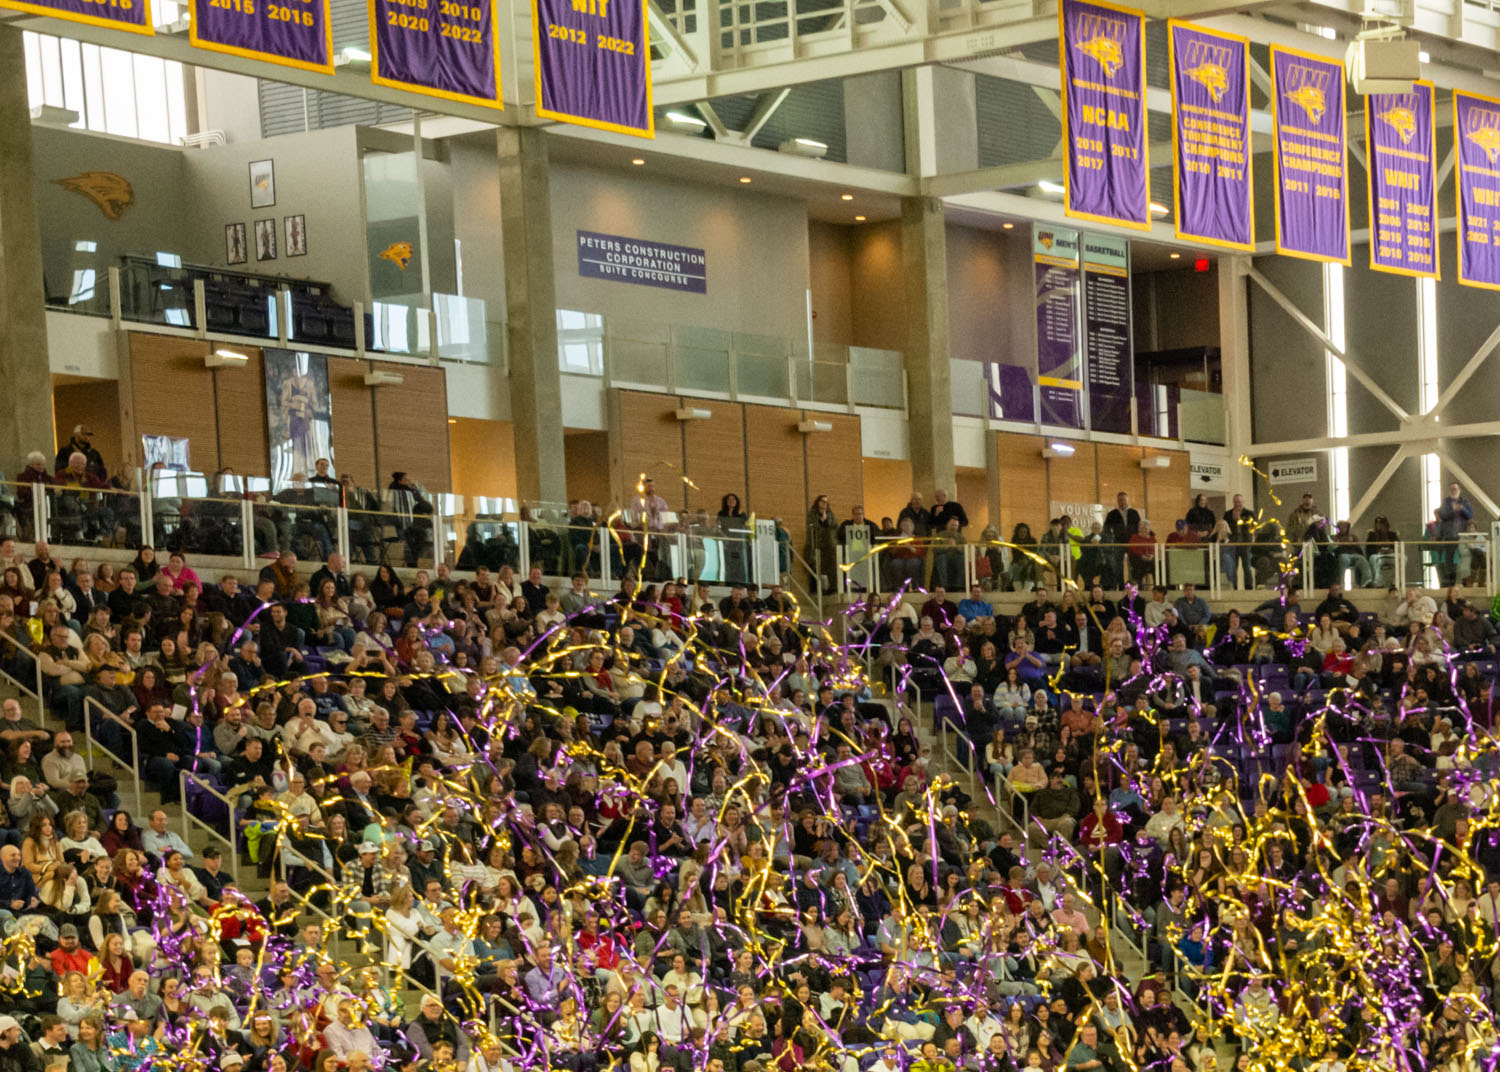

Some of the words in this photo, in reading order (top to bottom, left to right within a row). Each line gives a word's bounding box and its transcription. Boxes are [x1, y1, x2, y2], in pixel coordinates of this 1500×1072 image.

[268, 5, 314, 26] 2016
[440, 1, 481, 21] 2010
[571, 0, 609, 17] NIT
[388, 11, 429, 32] 2020
[441, 23, 483, 44] 2022
[1076, 12, 1127, 40] UNI
[549, 24, 587, 44] 2012
[598, 35, 635, 55] 2022
[1185, 39, 1232, 69] UNI
[1286, 63, 1330, 93] UNI
[1082, 104, 1129, 132] NCAA
[1184, 117, 1241, 139] CONFERENCE
[1076, 136, 1103, 153] 2010
[1111, 144, 1137, 159] 2011
[1183, 129, 1243, 151] TOURNAMENT
[1184, 141, 1244, 164] CHAMPIONS
[1281, 140, 1341, 163] CONFERENCE
[1077, 155, 1103, 171] 2017
[1185, 159, 1211, 175] 2010
[1217, 165, 1242, 181] 2011
[1282, 155, 1342, 178] CHAMPIONS
[1285, 179, 1308, 193] 2011
[1385, 168, 1420, 191] WNIT
[580, 236, 621, 252] PETERS
[625, 244, 705, 265] CONSTRUCTION
[1085, 244, 1126, 258] BASKETBALL
[606, 252, 681, 273] CORPORATION
[599, 264, 627, 276] SUITE
[631, 269, 689, 285] CONCOURSE
[1190, 464, 1221, 475] ELEVATOR
[1281, 466, 1314, 476] ELEVATOR
[848, 529, 870, 541] 101
